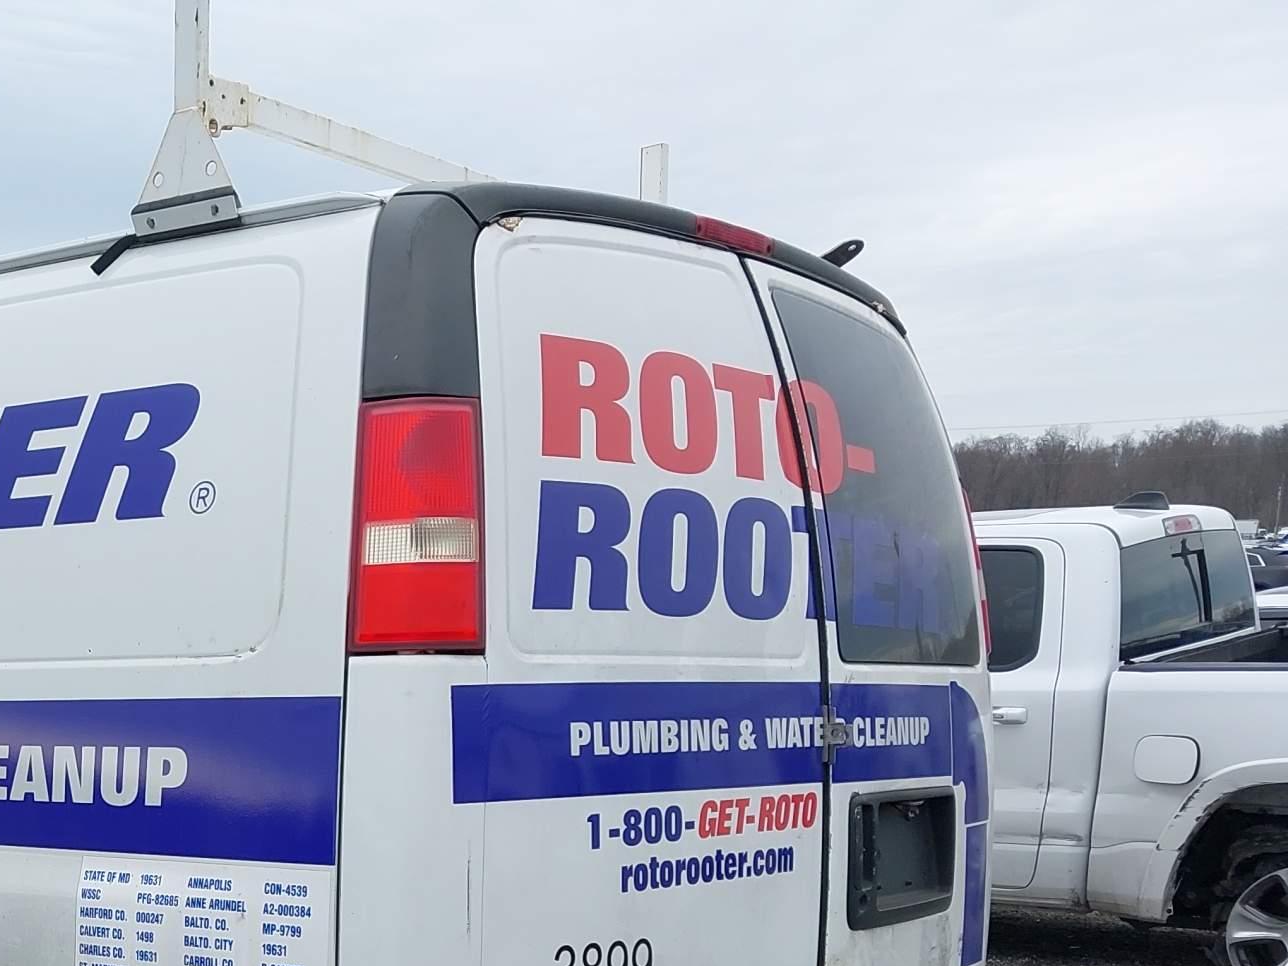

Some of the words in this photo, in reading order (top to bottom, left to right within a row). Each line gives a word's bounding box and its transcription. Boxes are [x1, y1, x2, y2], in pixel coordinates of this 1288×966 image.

[539, 333, 876, 495] ROTO-
[532, 480, 941, 634] ROOTER
[569, 718, 729, 757] PLUMBING
[738, 719, 758, 750] &
[765, 716, 846, 748] WATE
[852, 717, 930, 747] CLEANUP
[587, 792, 818, 850] 1-800-GET-ROTO
[84, 870, 106, 881] STATE
[107, 872, 116, 883] OF
[118, 872, 131, 883] MD
[140, 874, 162, 886] 19631
[621, 846, 794, 893] rotorooter.com
[81, 888, 101, 900] WSSC
[187, 877, 232, 891] ANNAPOLIS
[264, 882, 308, 897] CON-4539
[185, 896, 207, 909] ANNE
[208, 898, 247, 913] ARUNDEL
[80, 907, 113, 920] HARFORD
[115, 909, 128, 921] CO.
[136, 911, 164, 925] 000247
[79, 925, 110, 938] CALVERT
[112, 928, 125, 940] CO.
[136, 931, 154, 943] 1498
[184, 916, 212, 929] BALTO.
[215, 918, 229, 931] CO.
[262, 923, 302, 938] MP-9799
[79, 943, 111, 958] CHARLES
[112, 947, 125, 959] CO.
[136, 949, 158, 962] 19631
[184, 935, 212, 949] BALTO.
[214, 938, 234, 951] CITY
[262, 943, 287, 957] 19631
